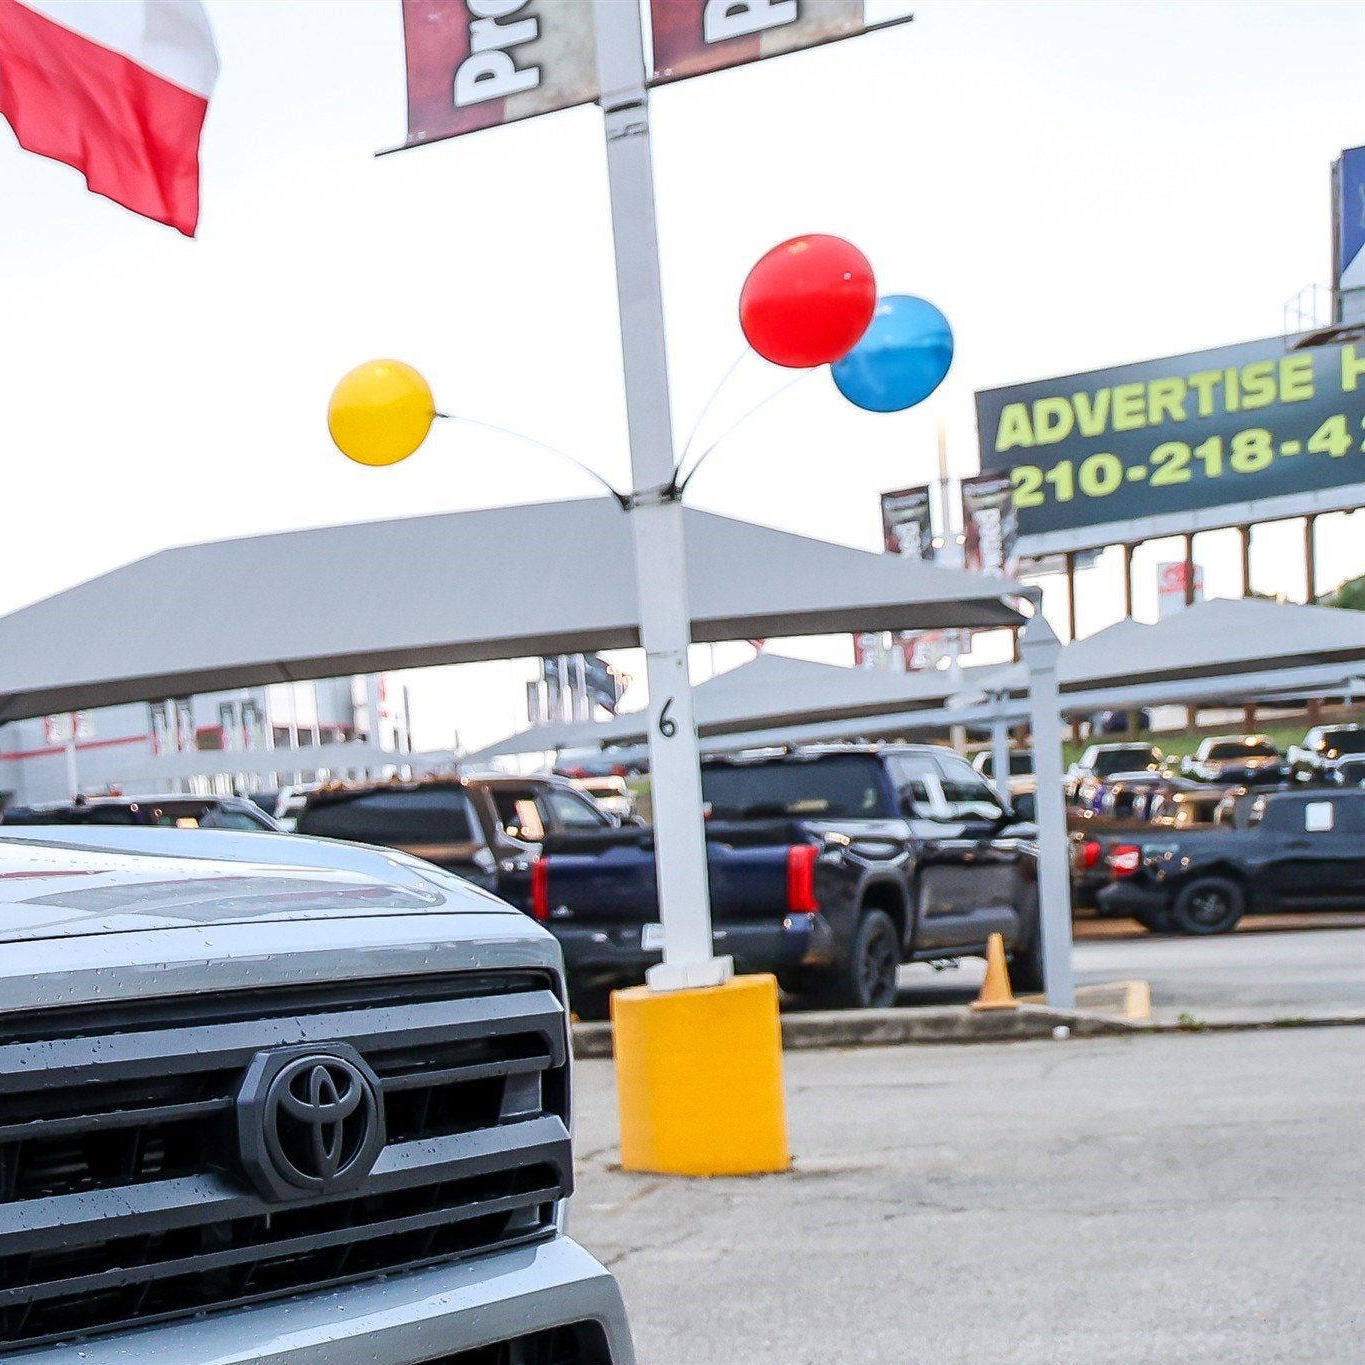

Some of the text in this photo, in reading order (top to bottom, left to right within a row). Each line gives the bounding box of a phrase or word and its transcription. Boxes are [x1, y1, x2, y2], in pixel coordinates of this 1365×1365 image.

[995, 353, 1315, 452] ADVERTISE
[1010, 413, 1365, 509] 210-218-4
[658, 695, 676, 738] 6
